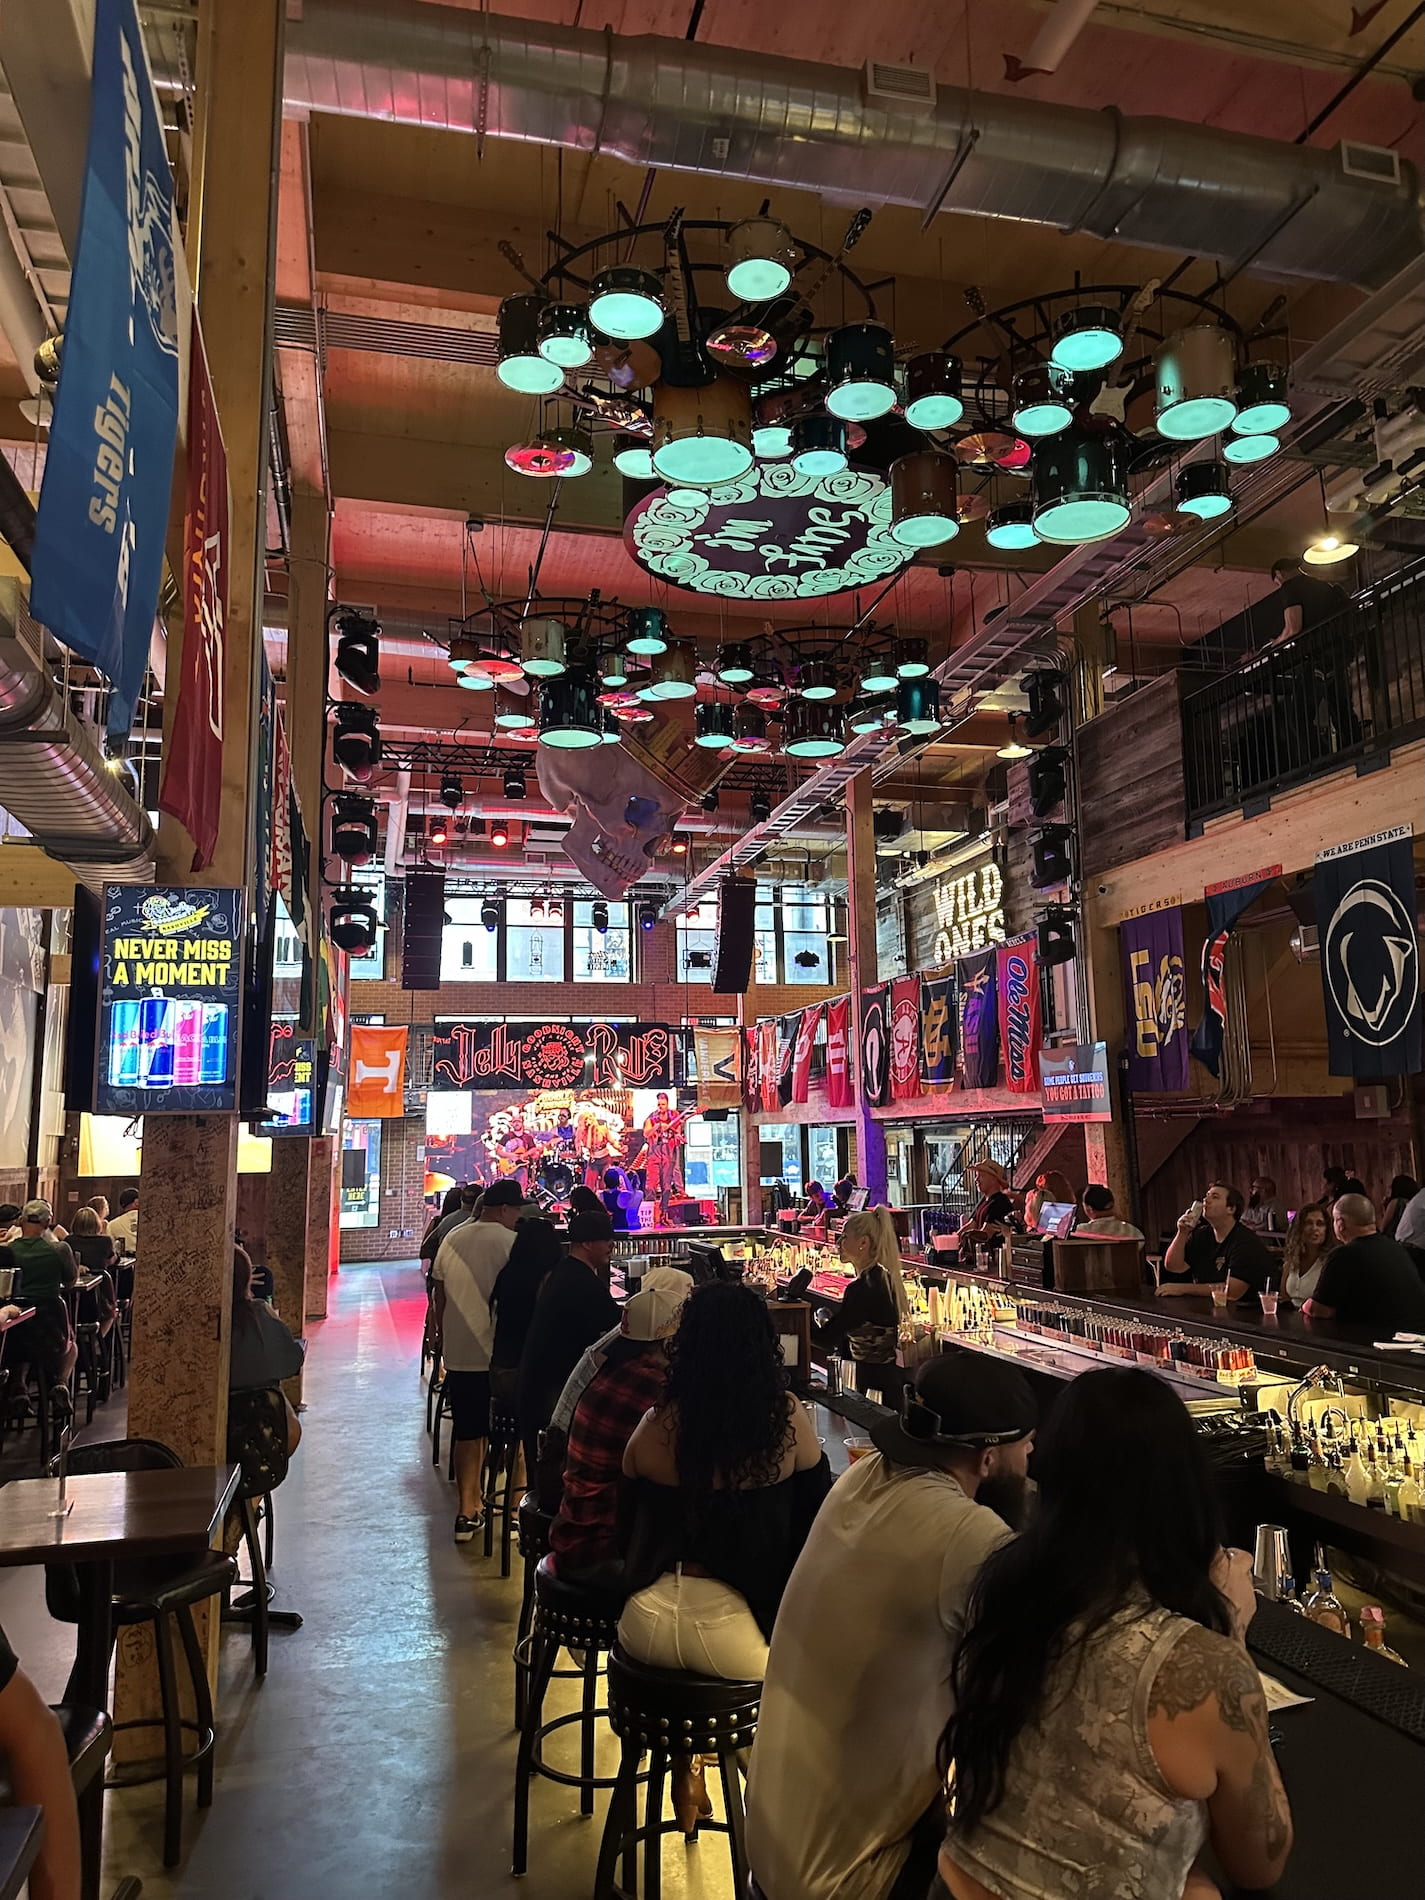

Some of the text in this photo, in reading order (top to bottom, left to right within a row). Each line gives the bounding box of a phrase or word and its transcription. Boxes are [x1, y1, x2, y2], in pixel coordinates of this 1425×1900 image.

[88, 371, 131, 534] Tigers
[1323, 826, 1406, 858] WE ARE PENN STATE
[1222, 871, 1262, 889] AUBURN
[932, 863, 1004, 929] WILD
[1130, 898, 1170, 917] TIGERS
[114, 938, 232, 961] NEVER MISS
[933, 909, 1006, 963] ONES
[112, 961, 231, 986] A MOMENT
[1007, 955, 1030, 1084] Ole Miss
[521, 1023, 586, 1054] GOODNIGHT
[435, 1023, 522, 1088] Jelly
[521, 1058, 585, 1089] NASHVILLE
[1045, 1083, 1105, 1102] YOU GOT A TATTOO
